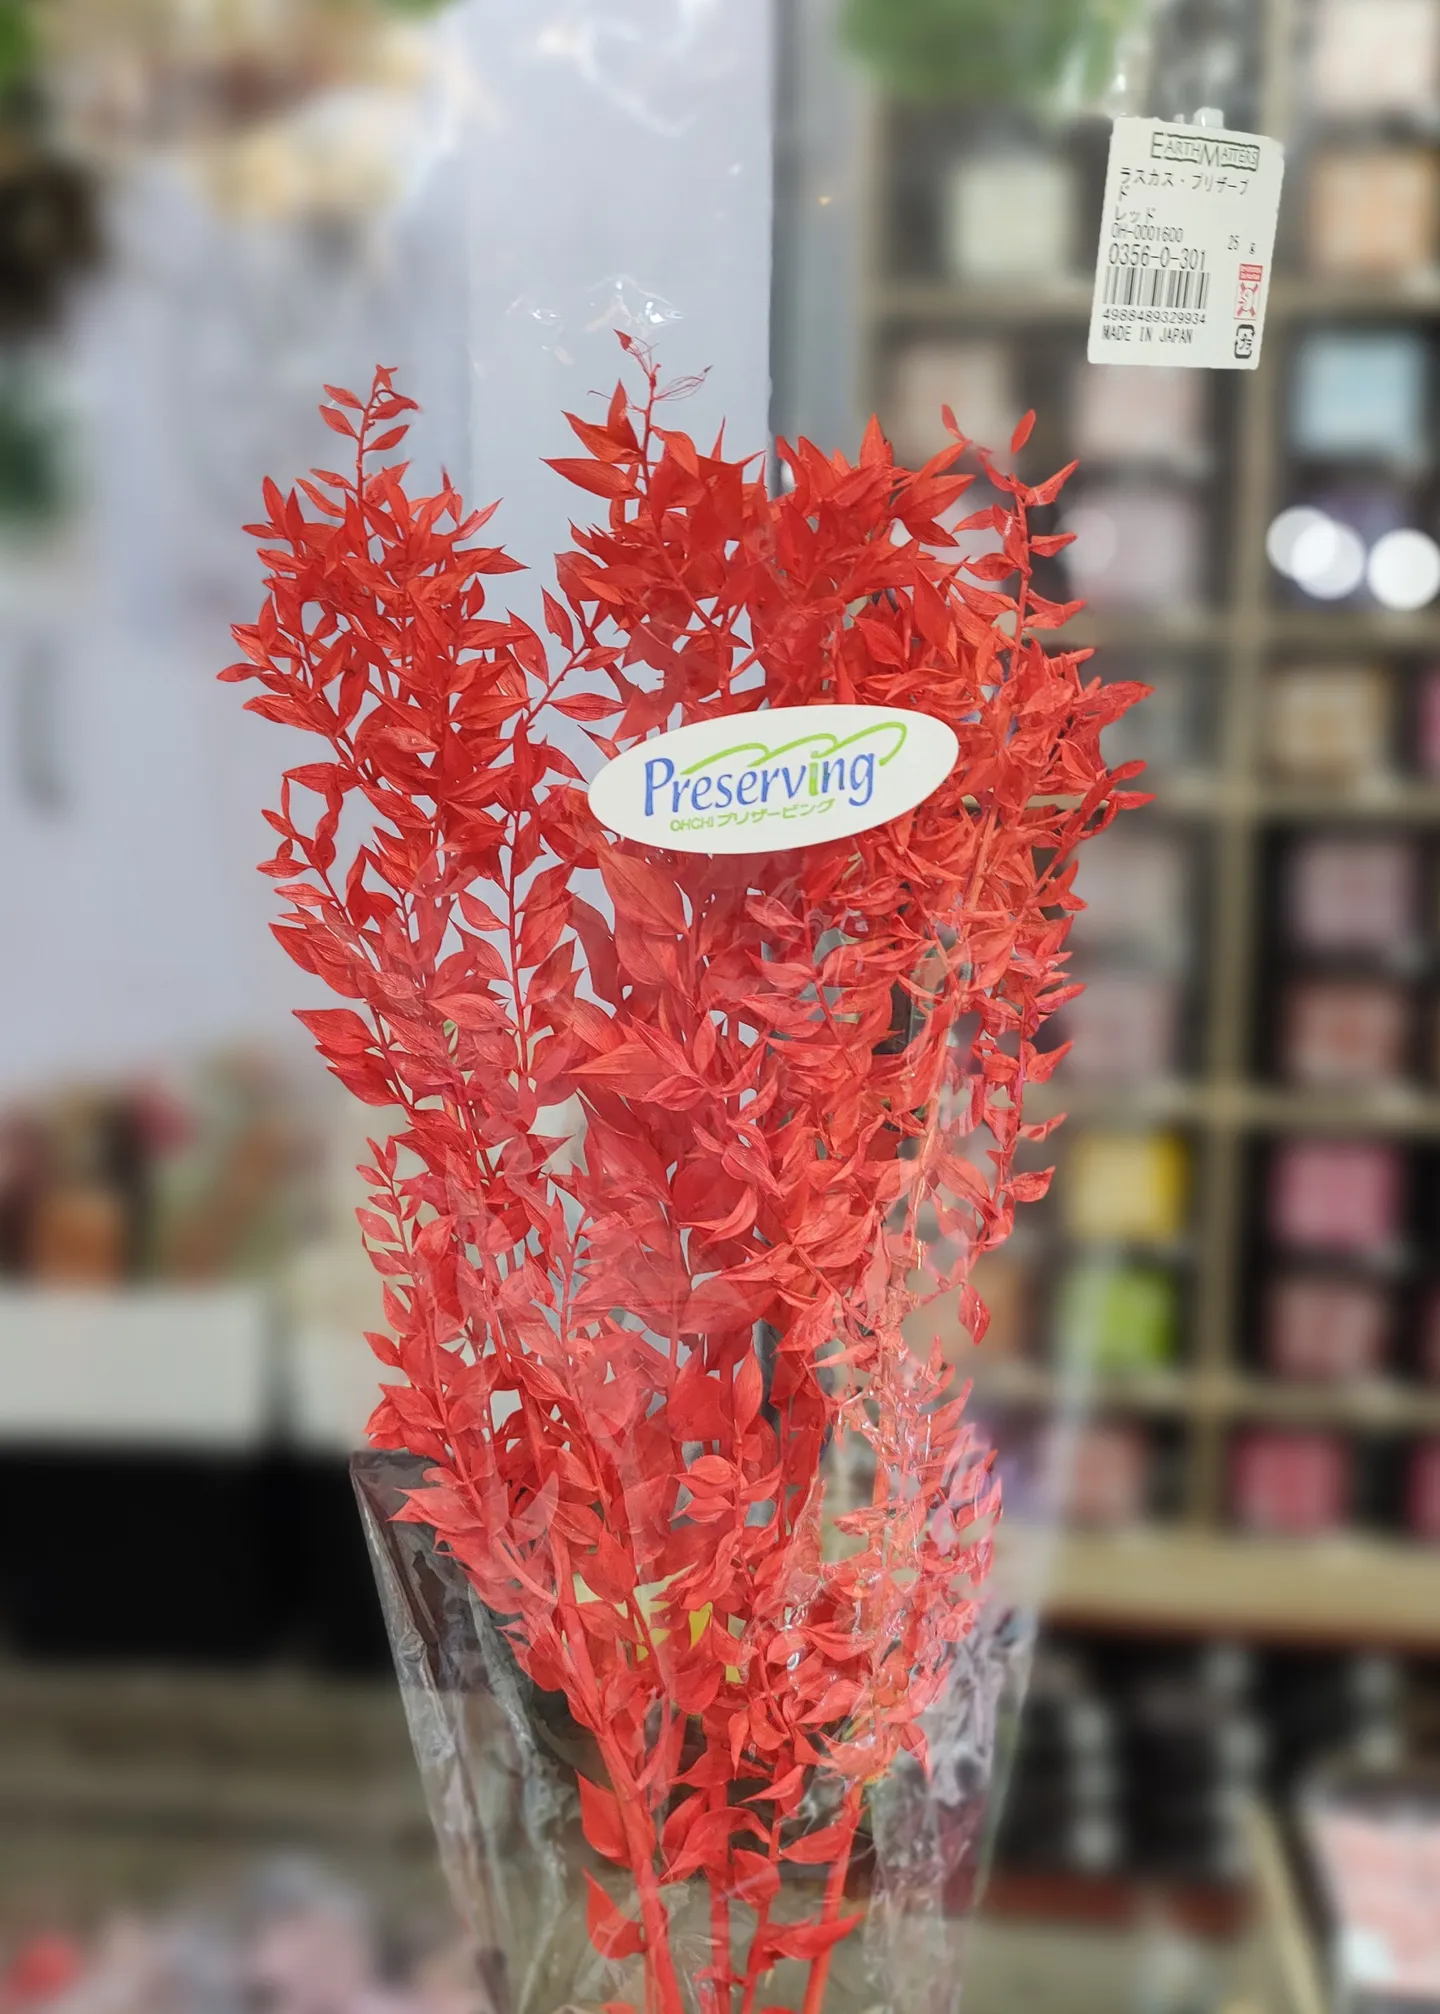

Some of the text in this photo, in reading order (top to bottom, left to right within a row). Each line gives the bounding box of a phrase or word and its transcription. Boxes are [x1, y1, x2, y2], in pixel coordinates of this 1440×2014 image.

[1114, 205, 1156, 224] レッド
[1109, 243, 1206, 271] 0356-0-301
[1102, 308, 1207, 325] 4988489329934
[1102, 324, 1193, 344] MADE IN JAPAN
[644, 751, 875, 817] Preserving
[669, 798, 836, 832] OHCHI プリザービング
